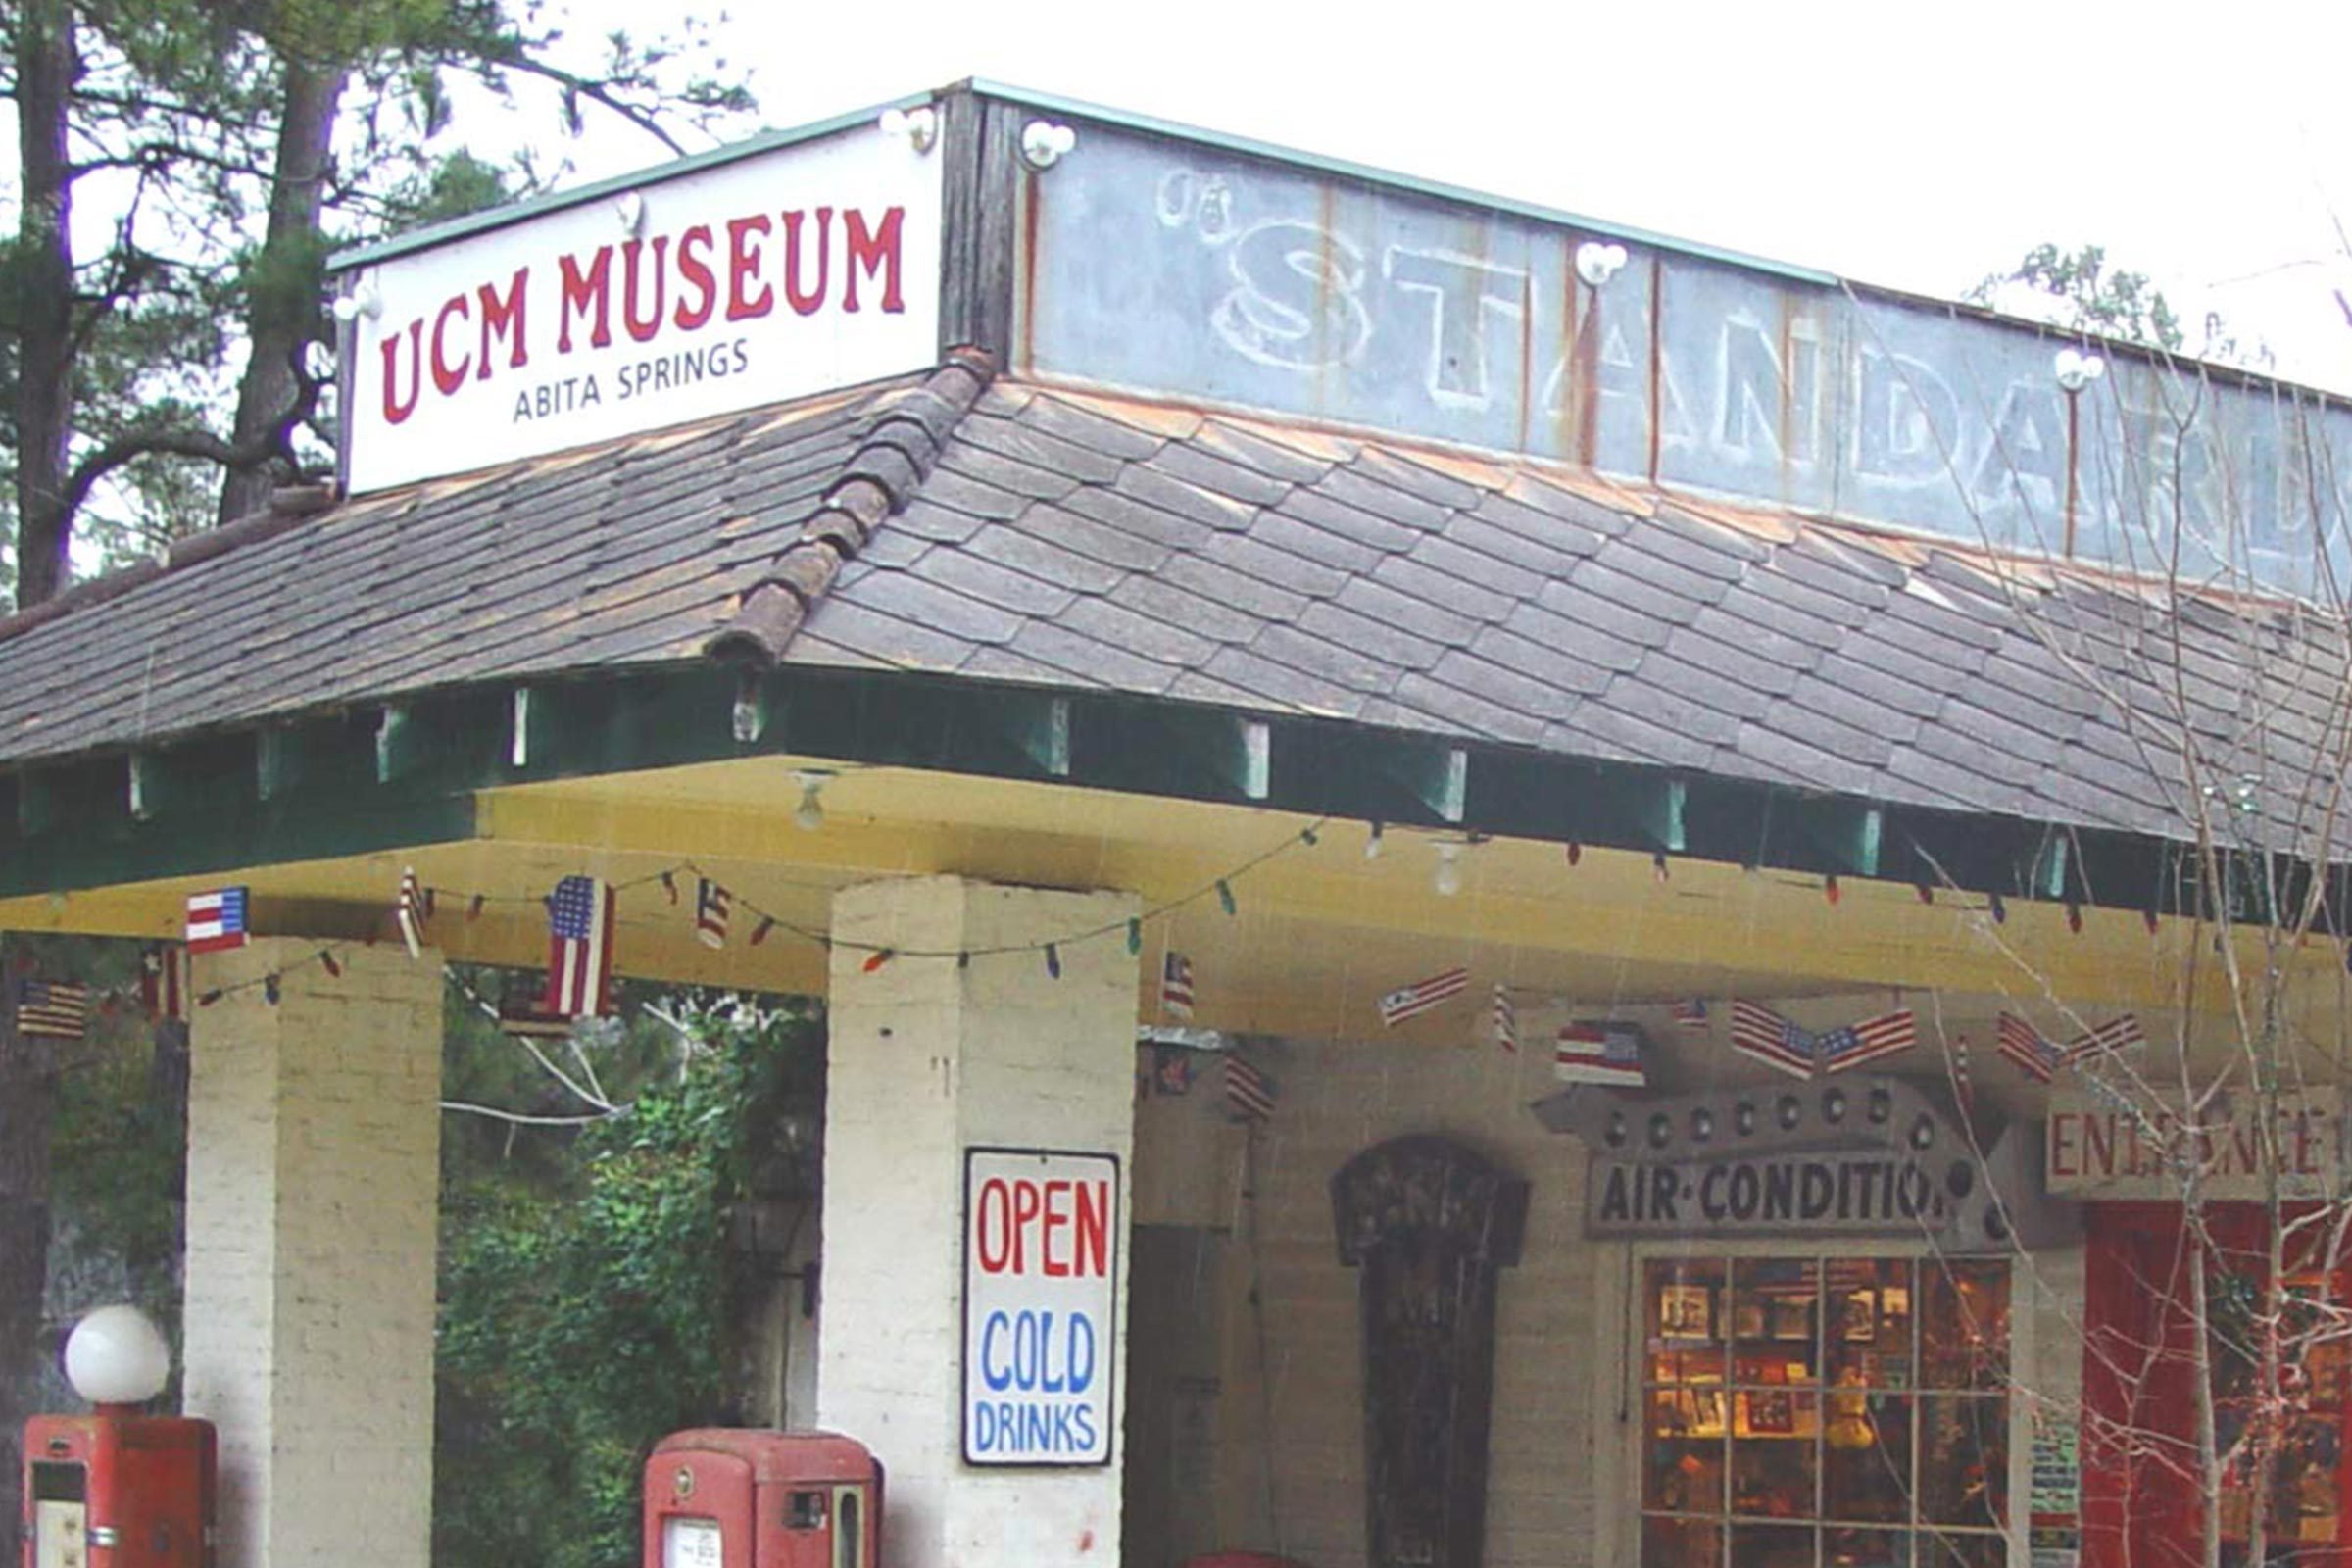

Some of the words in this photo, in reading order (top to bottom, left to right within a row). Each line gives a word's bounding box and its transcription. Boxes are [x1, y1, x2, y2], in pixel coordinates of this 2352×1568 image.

[378, 265, 530, 424] UCM
[557, 206, 905, 354] MUSEUM
[513, 376, 601, 423] ABITA
[618, 338, 750, 400] SPRINGS
[1209, 218, 2344, 562] STANDARD
[2052, 1107, 2326, 1176] ENTRNE
[977, 1177, 1108, 1278] OPEN
[982, 1309, 1095, 1394] COLD
[975, 1401, 1096, 1452] DRINKS
